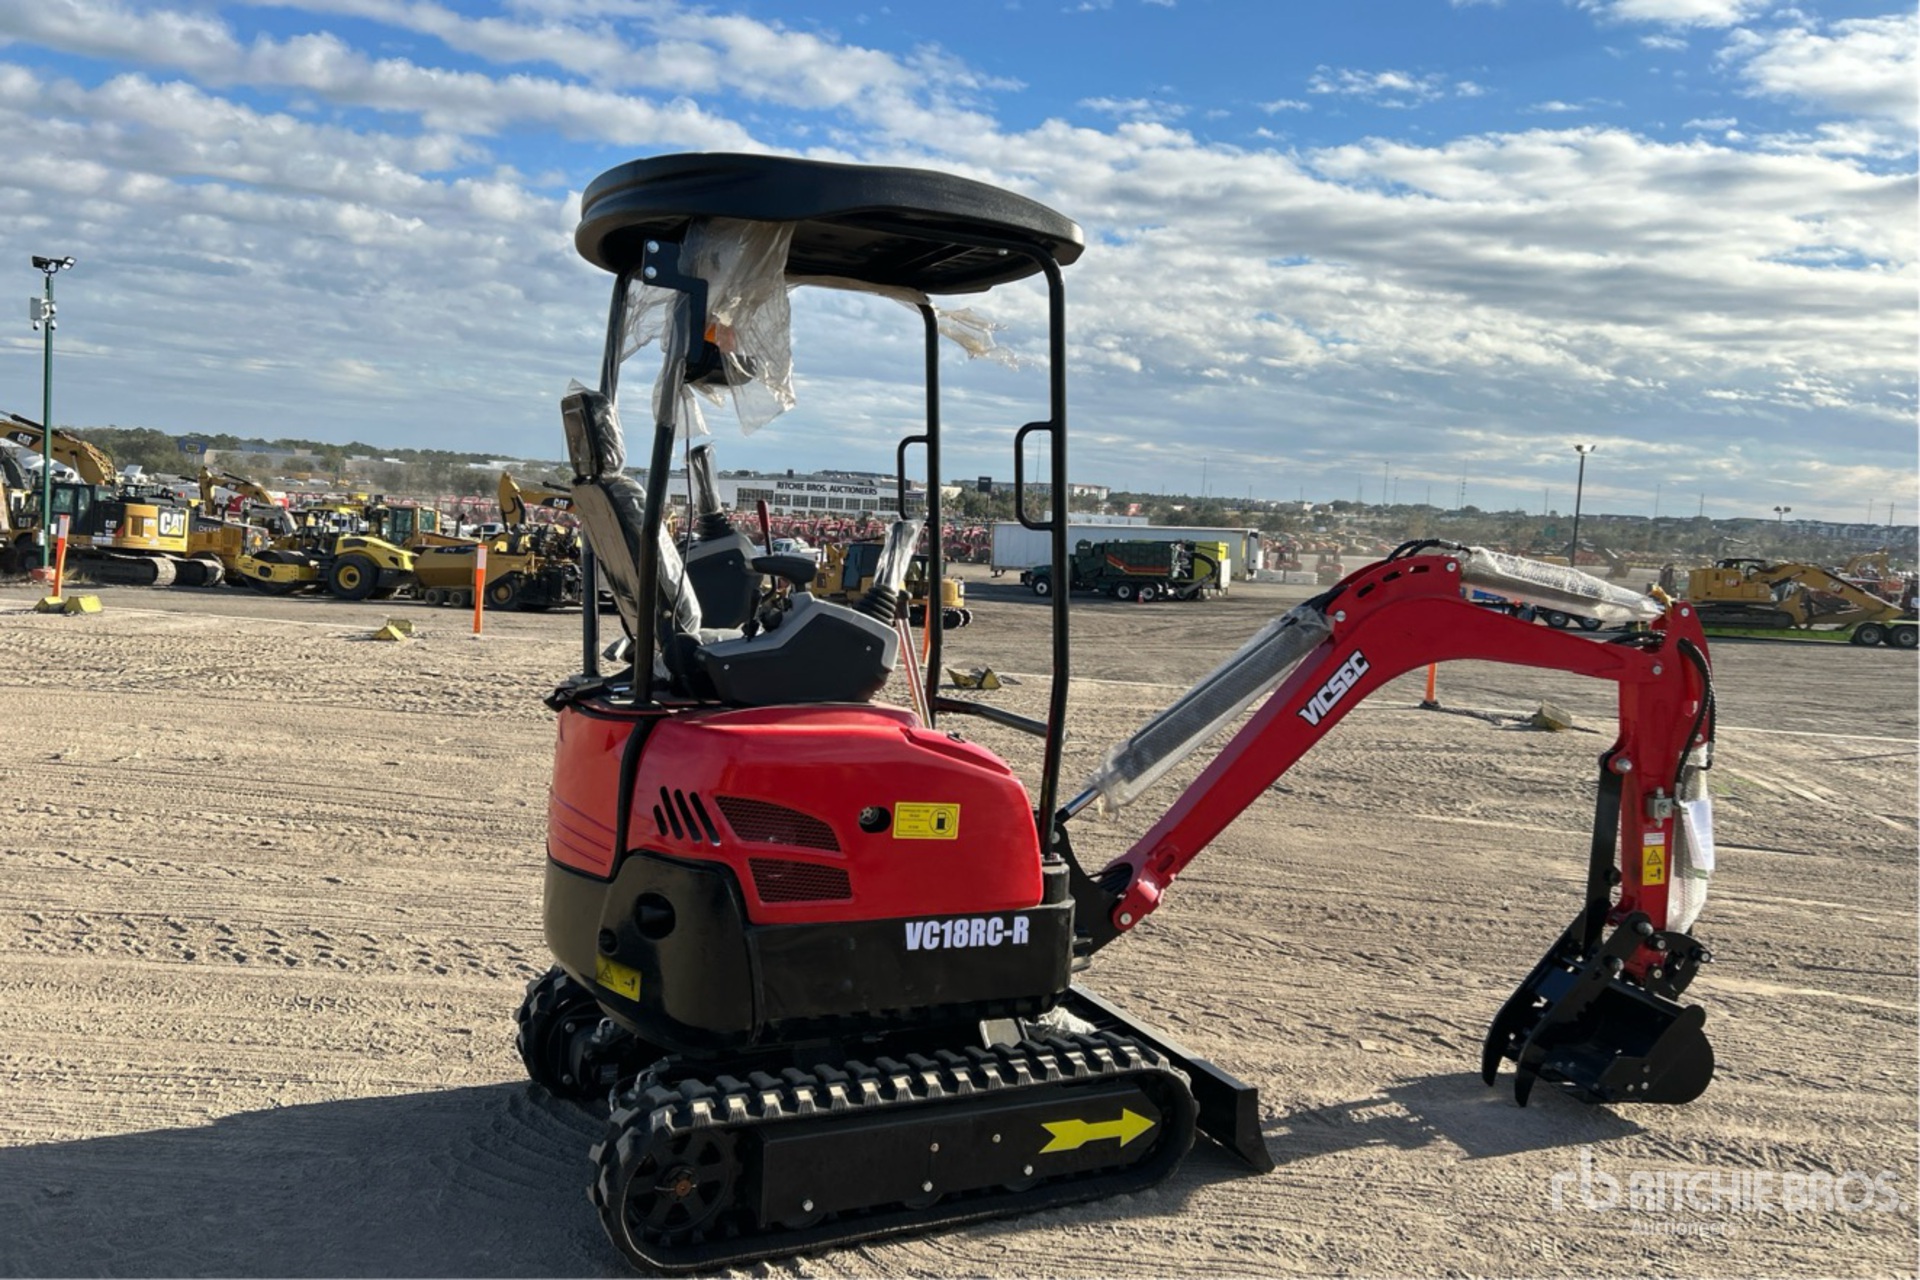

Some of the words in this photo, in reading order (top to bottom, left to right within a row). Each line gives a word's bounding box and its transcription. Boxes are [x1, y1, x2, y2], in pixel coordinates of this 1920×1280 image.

[17, 432, 33, 446] CAT
[777, 481, 804, 491] RITCHIE
[806, 483, 828, 492] BROS.
[829, 484, 878, 495] AUCTIONEERS
[553, 497, 569, 510] CAT
[105, 519, 117, 529] CAT
[160, 512, 185, 536] CAT
[198, 525, 221, 533] DEERE
[1297, 648, 1371, 728] VICSEC
[905, 916, 1030, 950] VC18RC-R
